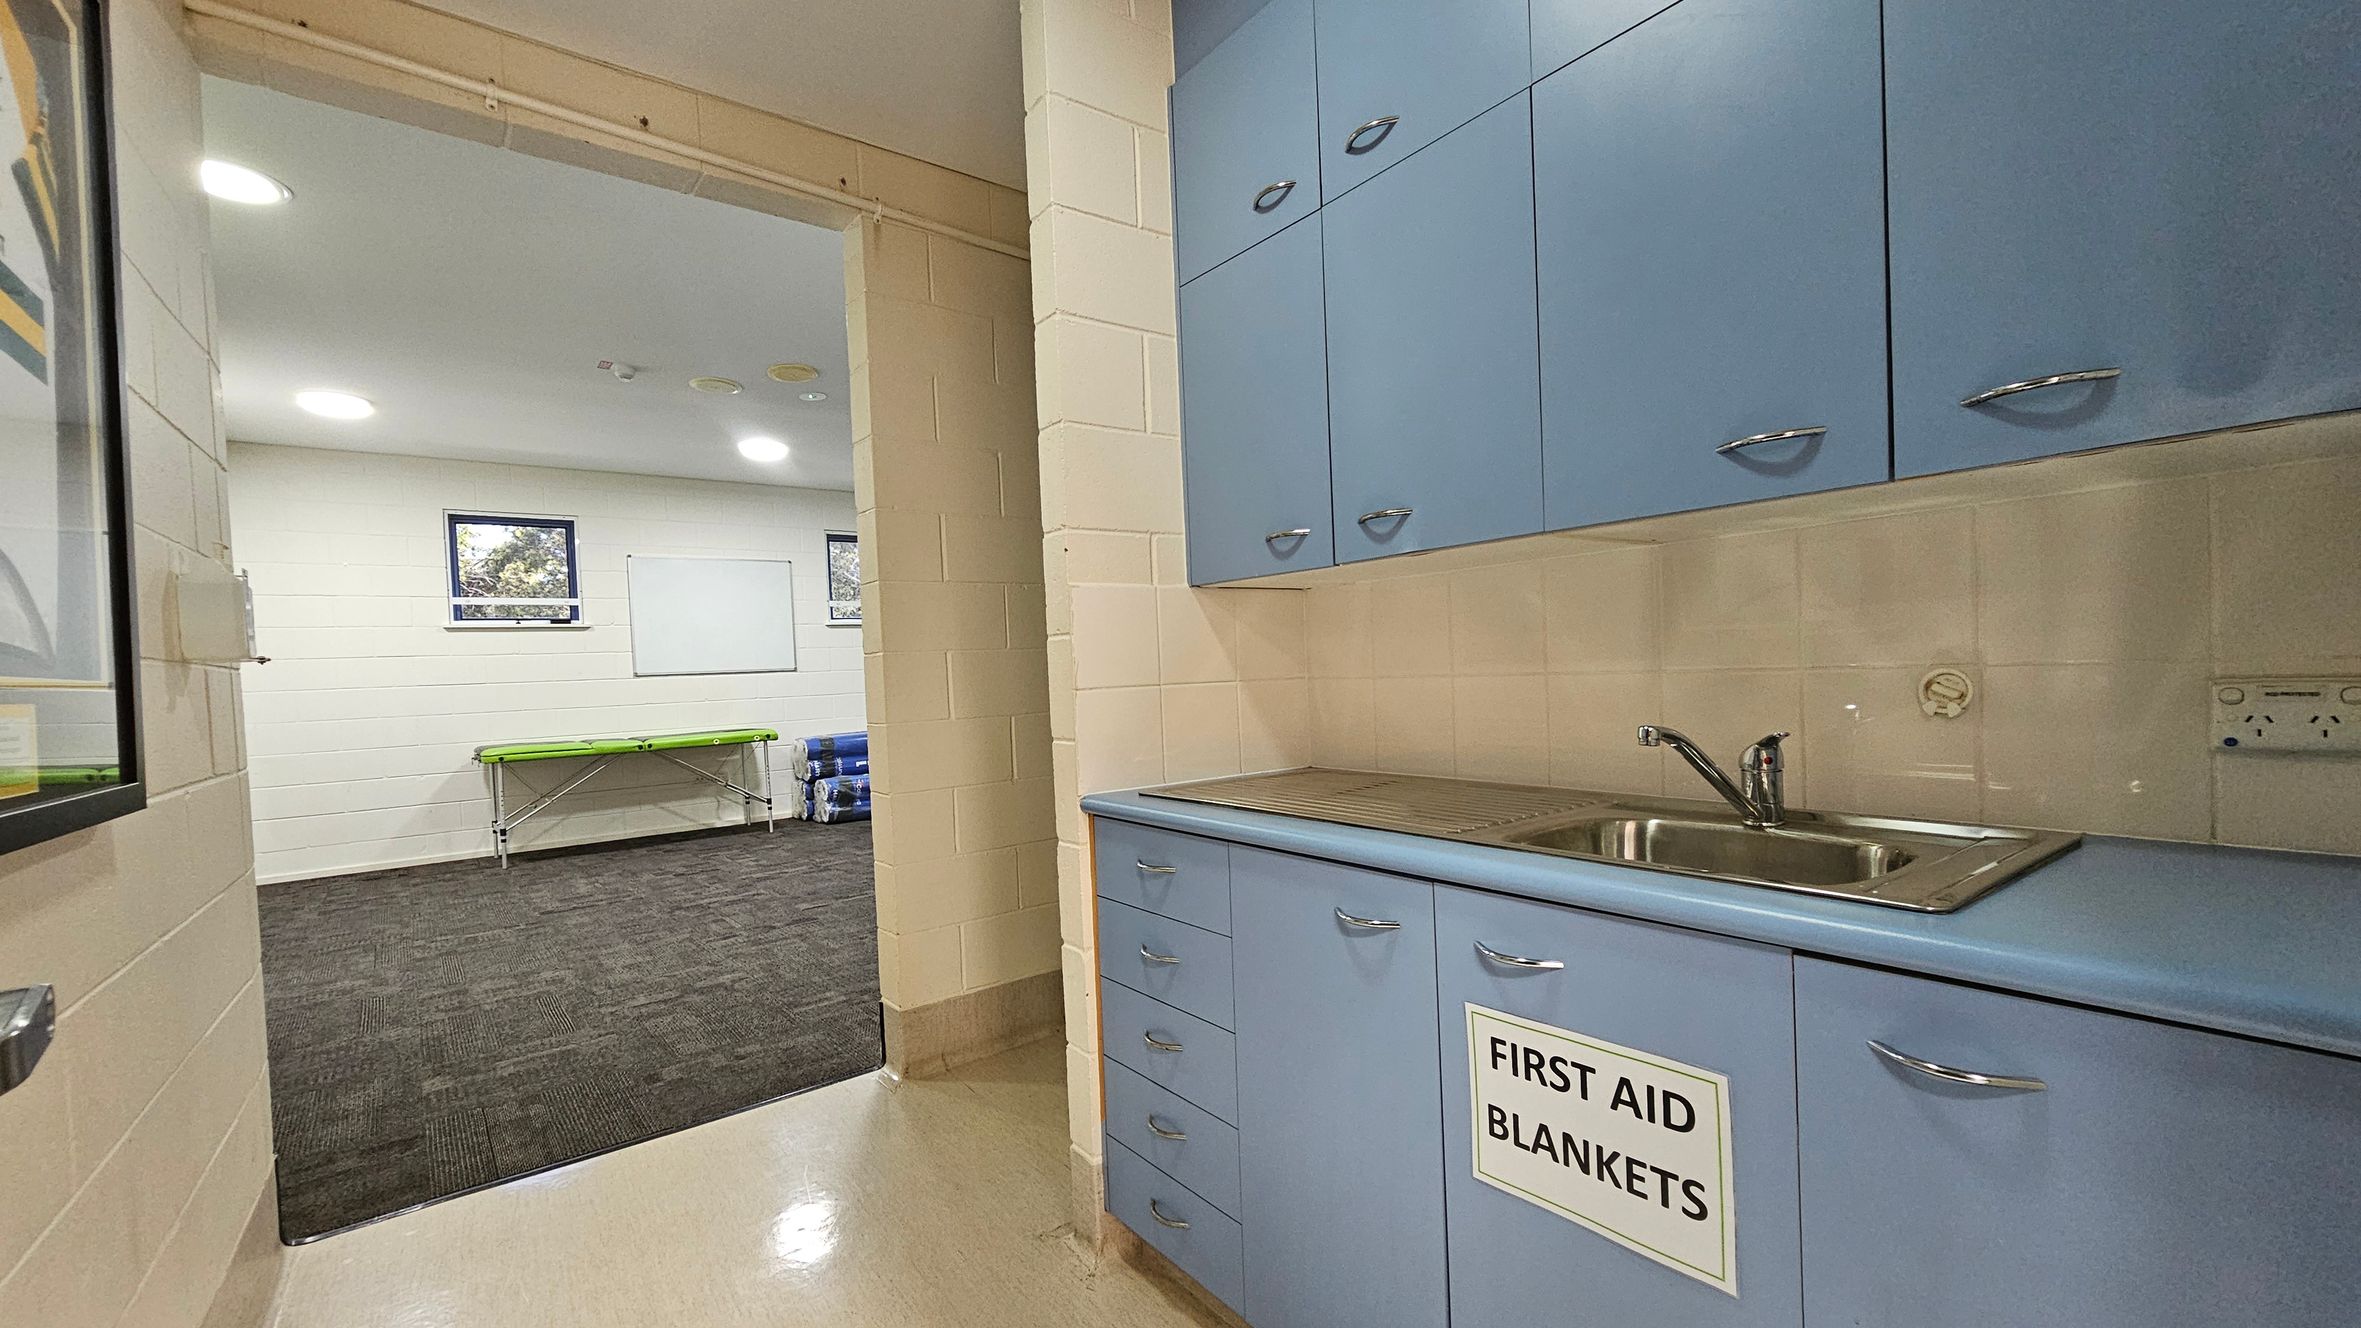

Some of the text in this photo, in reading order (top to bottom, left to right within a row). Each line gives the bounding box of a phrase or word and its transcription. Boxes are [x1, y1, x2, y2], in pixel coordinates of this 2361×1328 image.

[1490, 1036, 1696, 1133] FIRST AID
[1487, 1103, 1709, 1222] BLANKETS
